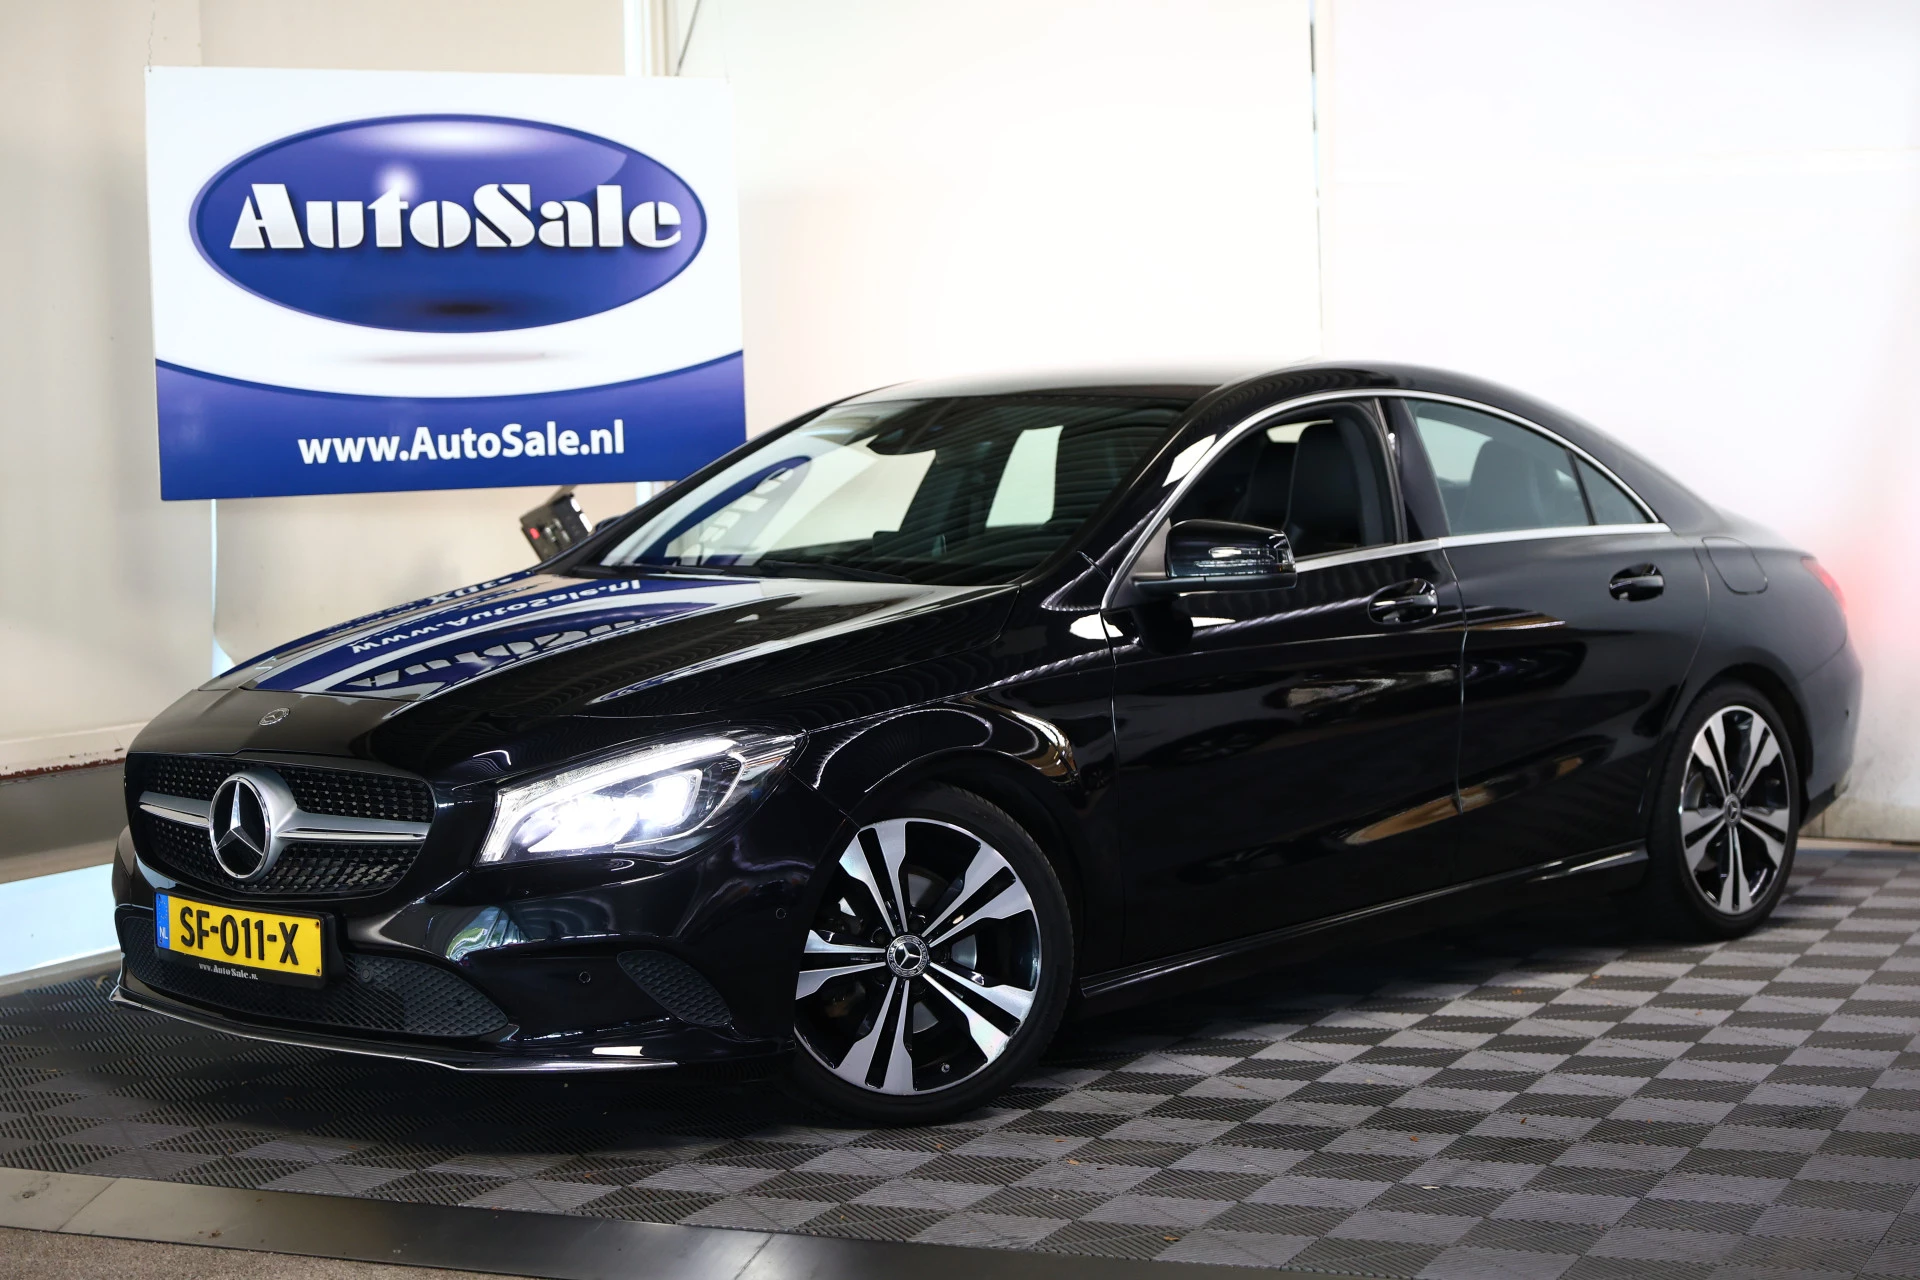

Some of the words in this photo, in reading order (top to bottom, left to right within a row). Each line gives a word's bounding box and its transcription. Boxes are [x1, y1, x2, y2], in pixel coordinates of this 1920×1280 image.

[229, 183, 682, 249] AutoSale
[297, 419, 625, 464] www.AutoSale.nl
[159, 925, 169, 940] NL
[180, 906, 299, 966] SF-011-X
